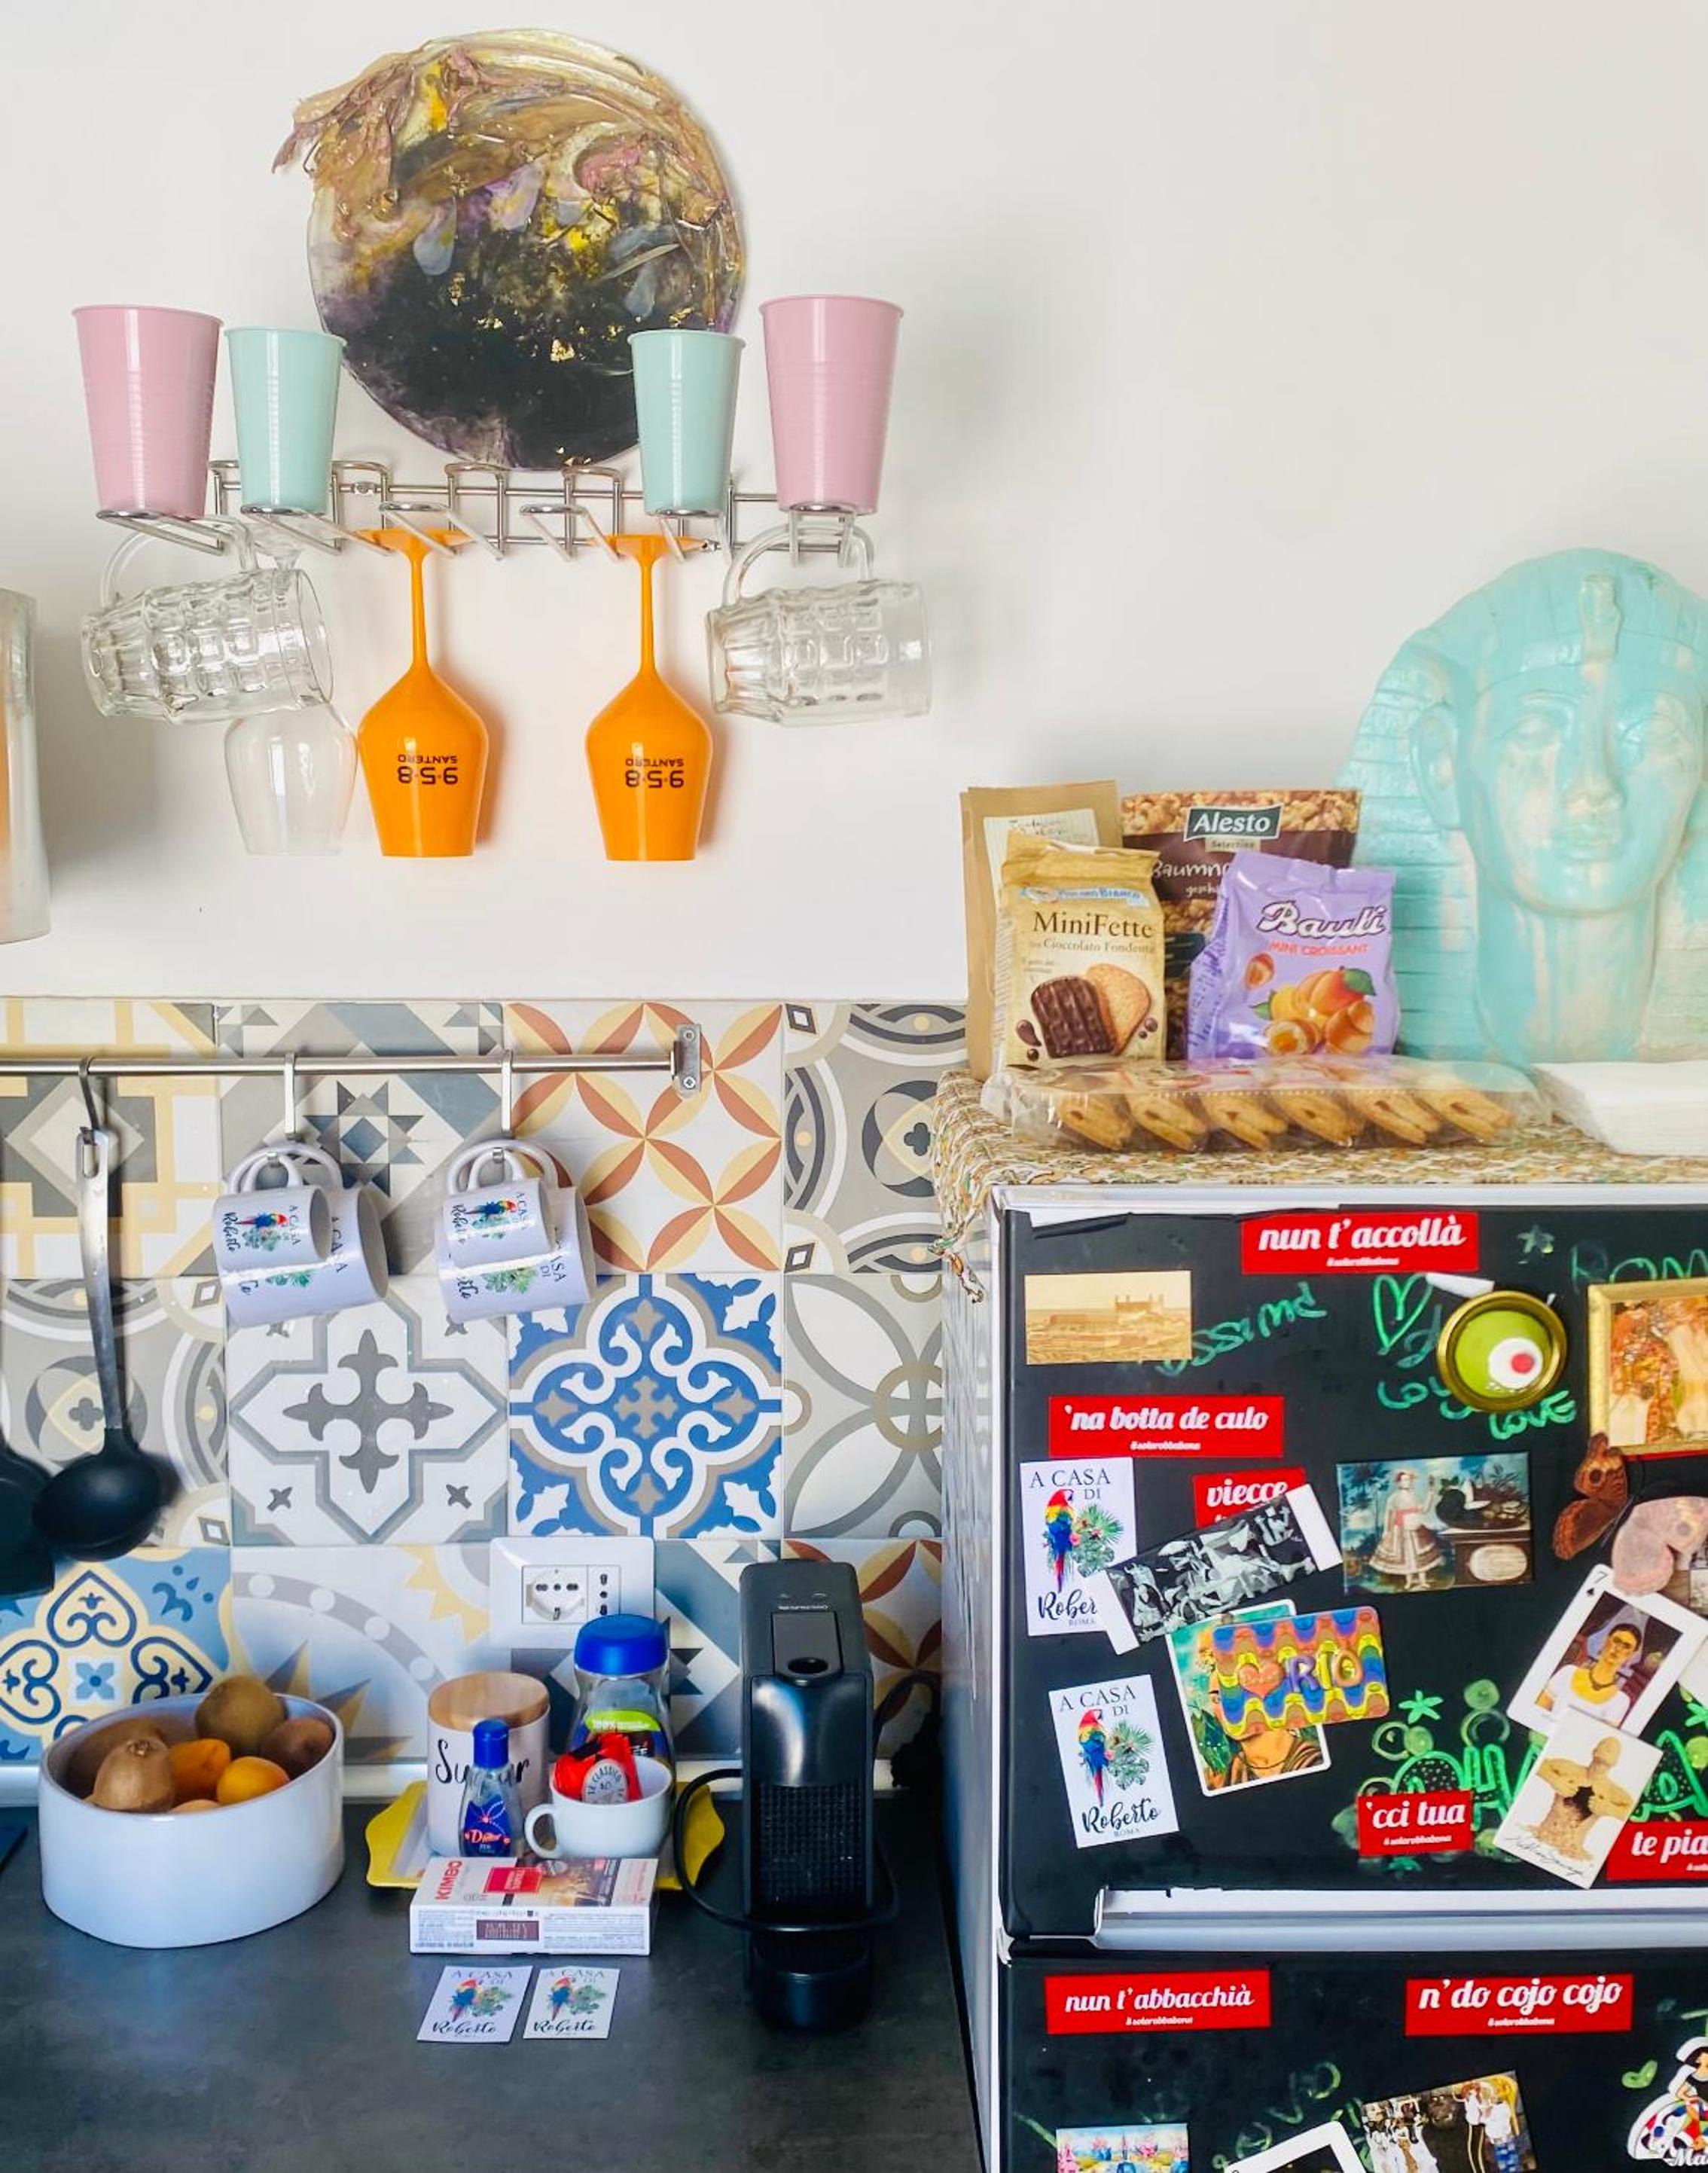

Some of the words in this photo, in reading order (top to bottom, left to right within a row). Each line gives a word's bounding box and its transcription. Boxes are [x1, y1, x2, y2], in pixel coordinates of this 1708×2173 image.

[1193, 812, 1271, 832] Alesto
[1033, 911, 1154, 938] MiniFette
[1256, 899, 1387, 939] Bauli
[1044, 938, 1101, 952] Cioccolato
[1269, 942, 1298, 954] MINI
[1302, 943, 1369, 957] CROISSANT
[1258, 1228, 1321, 1250] nun
[1328, 1214, 1467, 1250] t'accollà
[331, 1229, 348, 1273] CAA
[1064, 1405, 1105, 1430] 'na
[1109, 1405, 1175, 1430] botta
[1179, 1406, 1209, 1430] de
[1215, 1406, 1269, 1430] culo
[1030, 1471, 1045, 1488] A
[1051, 1468, 1111, 1487] CASA
[1084, 1488, 1101, 1500] DI
[1206, 1479, 1289, 1507] viecce
[1595, 1570, 1608, 1583] 7
[1038, 1589, 1097, 1620] Rober
[1289, 1648, 1364, 1692] RIO
[1060, 1695, 1074, 1712] A
[1080, 1685, 1136, 1707] CASA
[1112, 1705, 1130, 1717] DI
[1081, 1797, 1161, 1834] Roberto
[1365, 1800, 1410, 1829] 'cci
[1417, 1801, 1466, 1826] tua
[1631, 1831, 1658, 1857] te
[435, 1860, 463, 1900] KIMBO
[468, 1970, 512, 1979] CASA
[1065, 1995, 1110, 2013] nun
[1117, 1984, 1255, 2010] t'abbacchià
[1418, 1979, 1491, 2010] n'do
[1496, 1978, 1557, 2016] cojo
[1563, 1976, 1623, 2013] cojo
[432, 2019, 497, 2034] Roberto
[534, 2019, 596, 2034] Roberto
